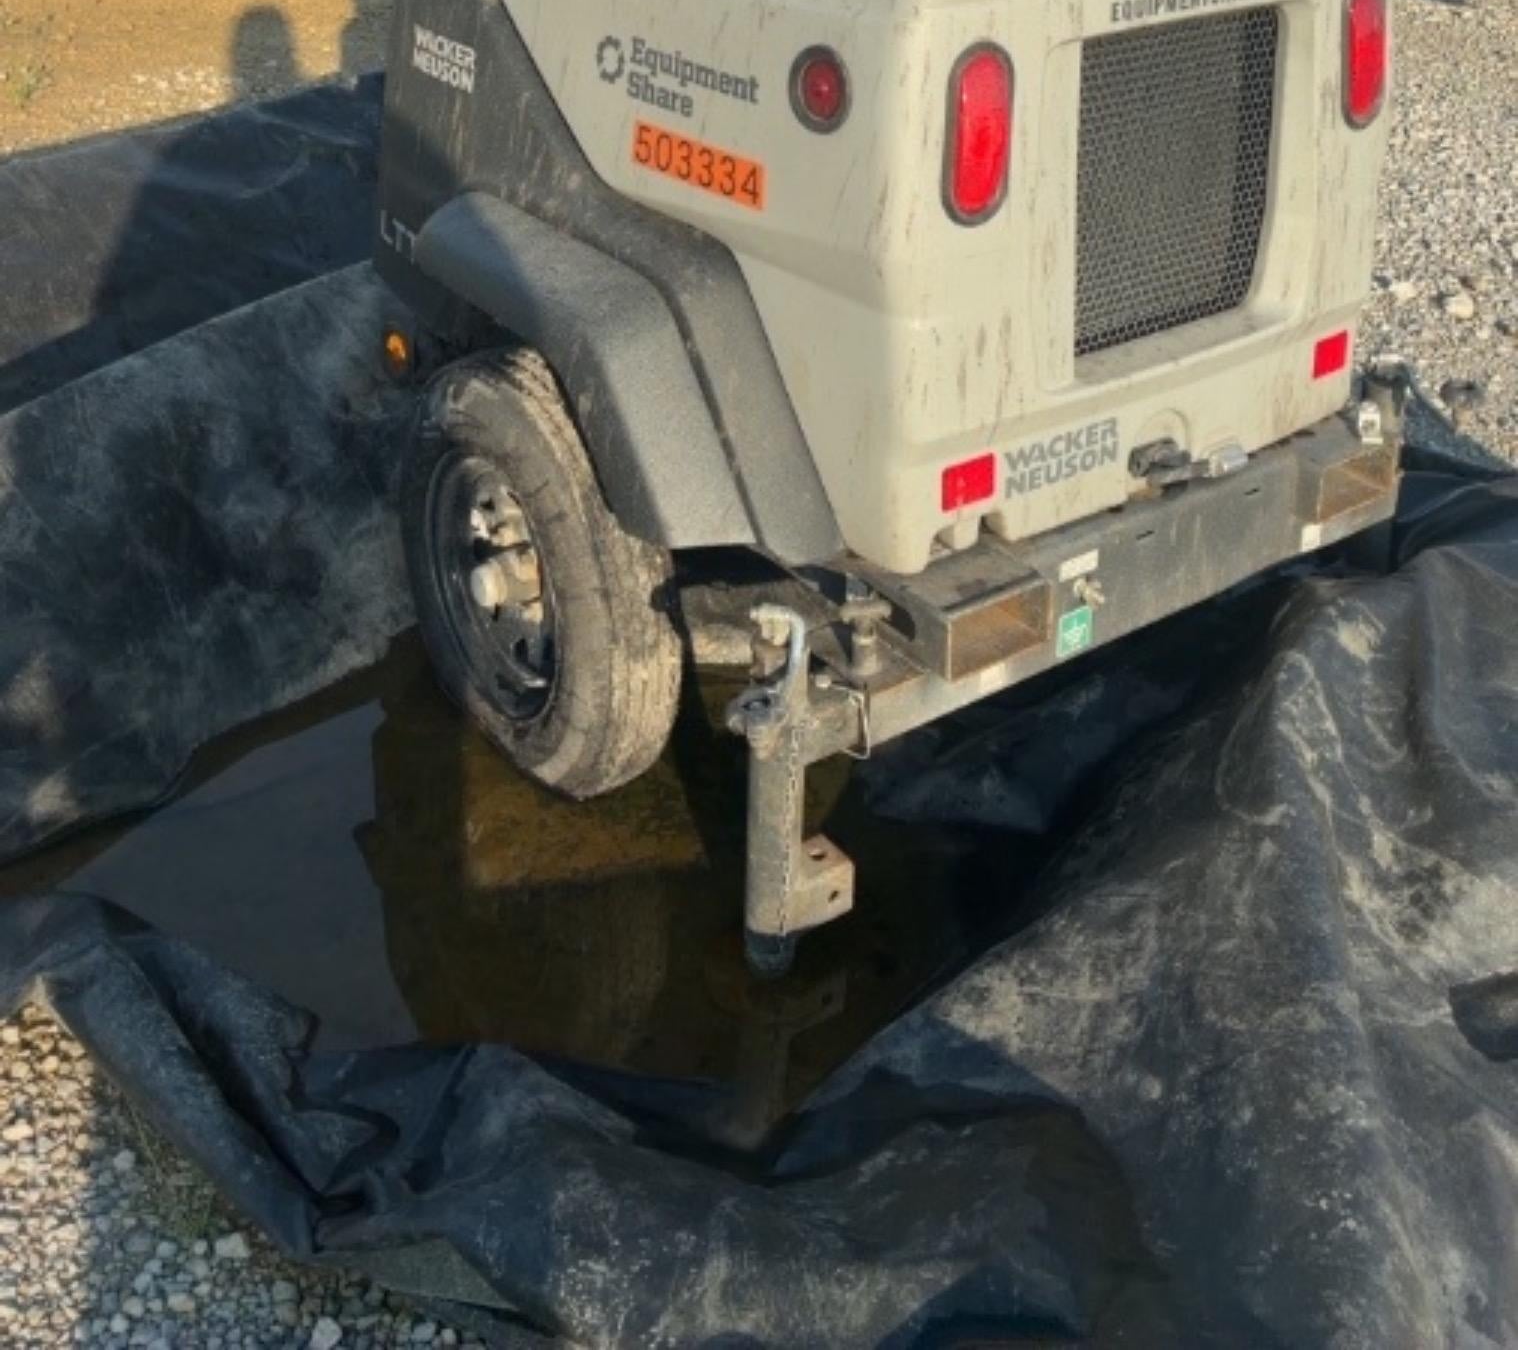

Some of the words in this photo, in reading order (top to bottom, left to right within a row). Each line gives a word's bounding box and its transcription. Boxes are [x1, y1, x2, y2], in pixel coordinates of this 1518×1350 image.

[414, 23, 476, 70] WACKER
[414, 47, 476, 94] NEUSON
[630, 35, 760, 105] Equipment
[626, 71, 694, 118] Share
[634, 124, 760, 206] 503334
[1004, 416, 1118, 473] WACKER
[1004, 439, 1118, 499] NEUSON
